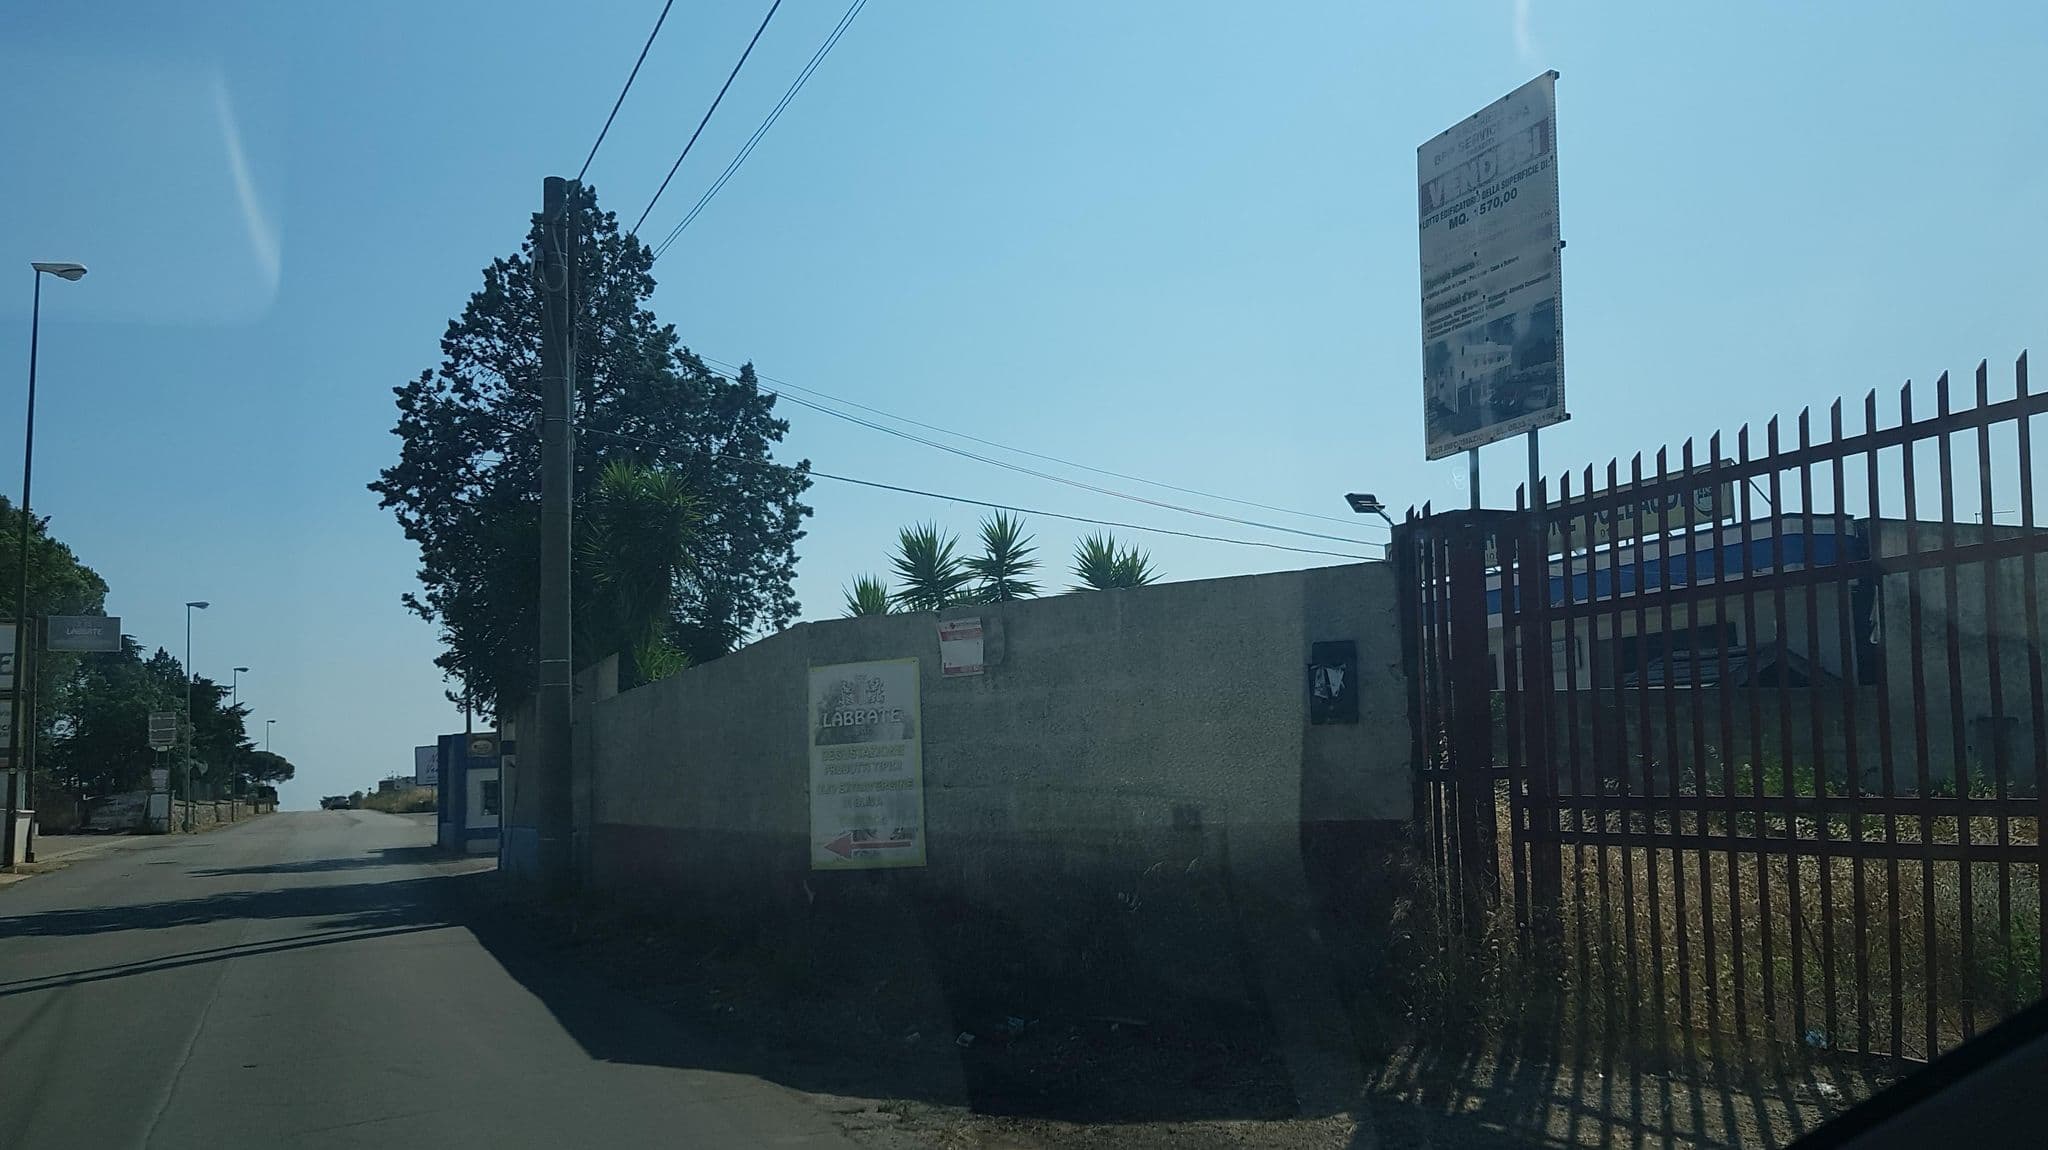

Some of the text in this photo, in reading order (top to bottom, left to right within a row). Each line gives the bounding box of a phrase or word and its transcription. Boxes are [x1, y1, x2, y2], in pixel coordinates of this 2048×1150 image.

[1422, 214, 1440, 230] LOTTO
[1481, 183, 1500, 200] DELLA
[1500, 164, 1539, 190] SUPERFICIE
[1449, 212, 1469, 231] MQ.
[822, 709, 903, 728] LABBATE
